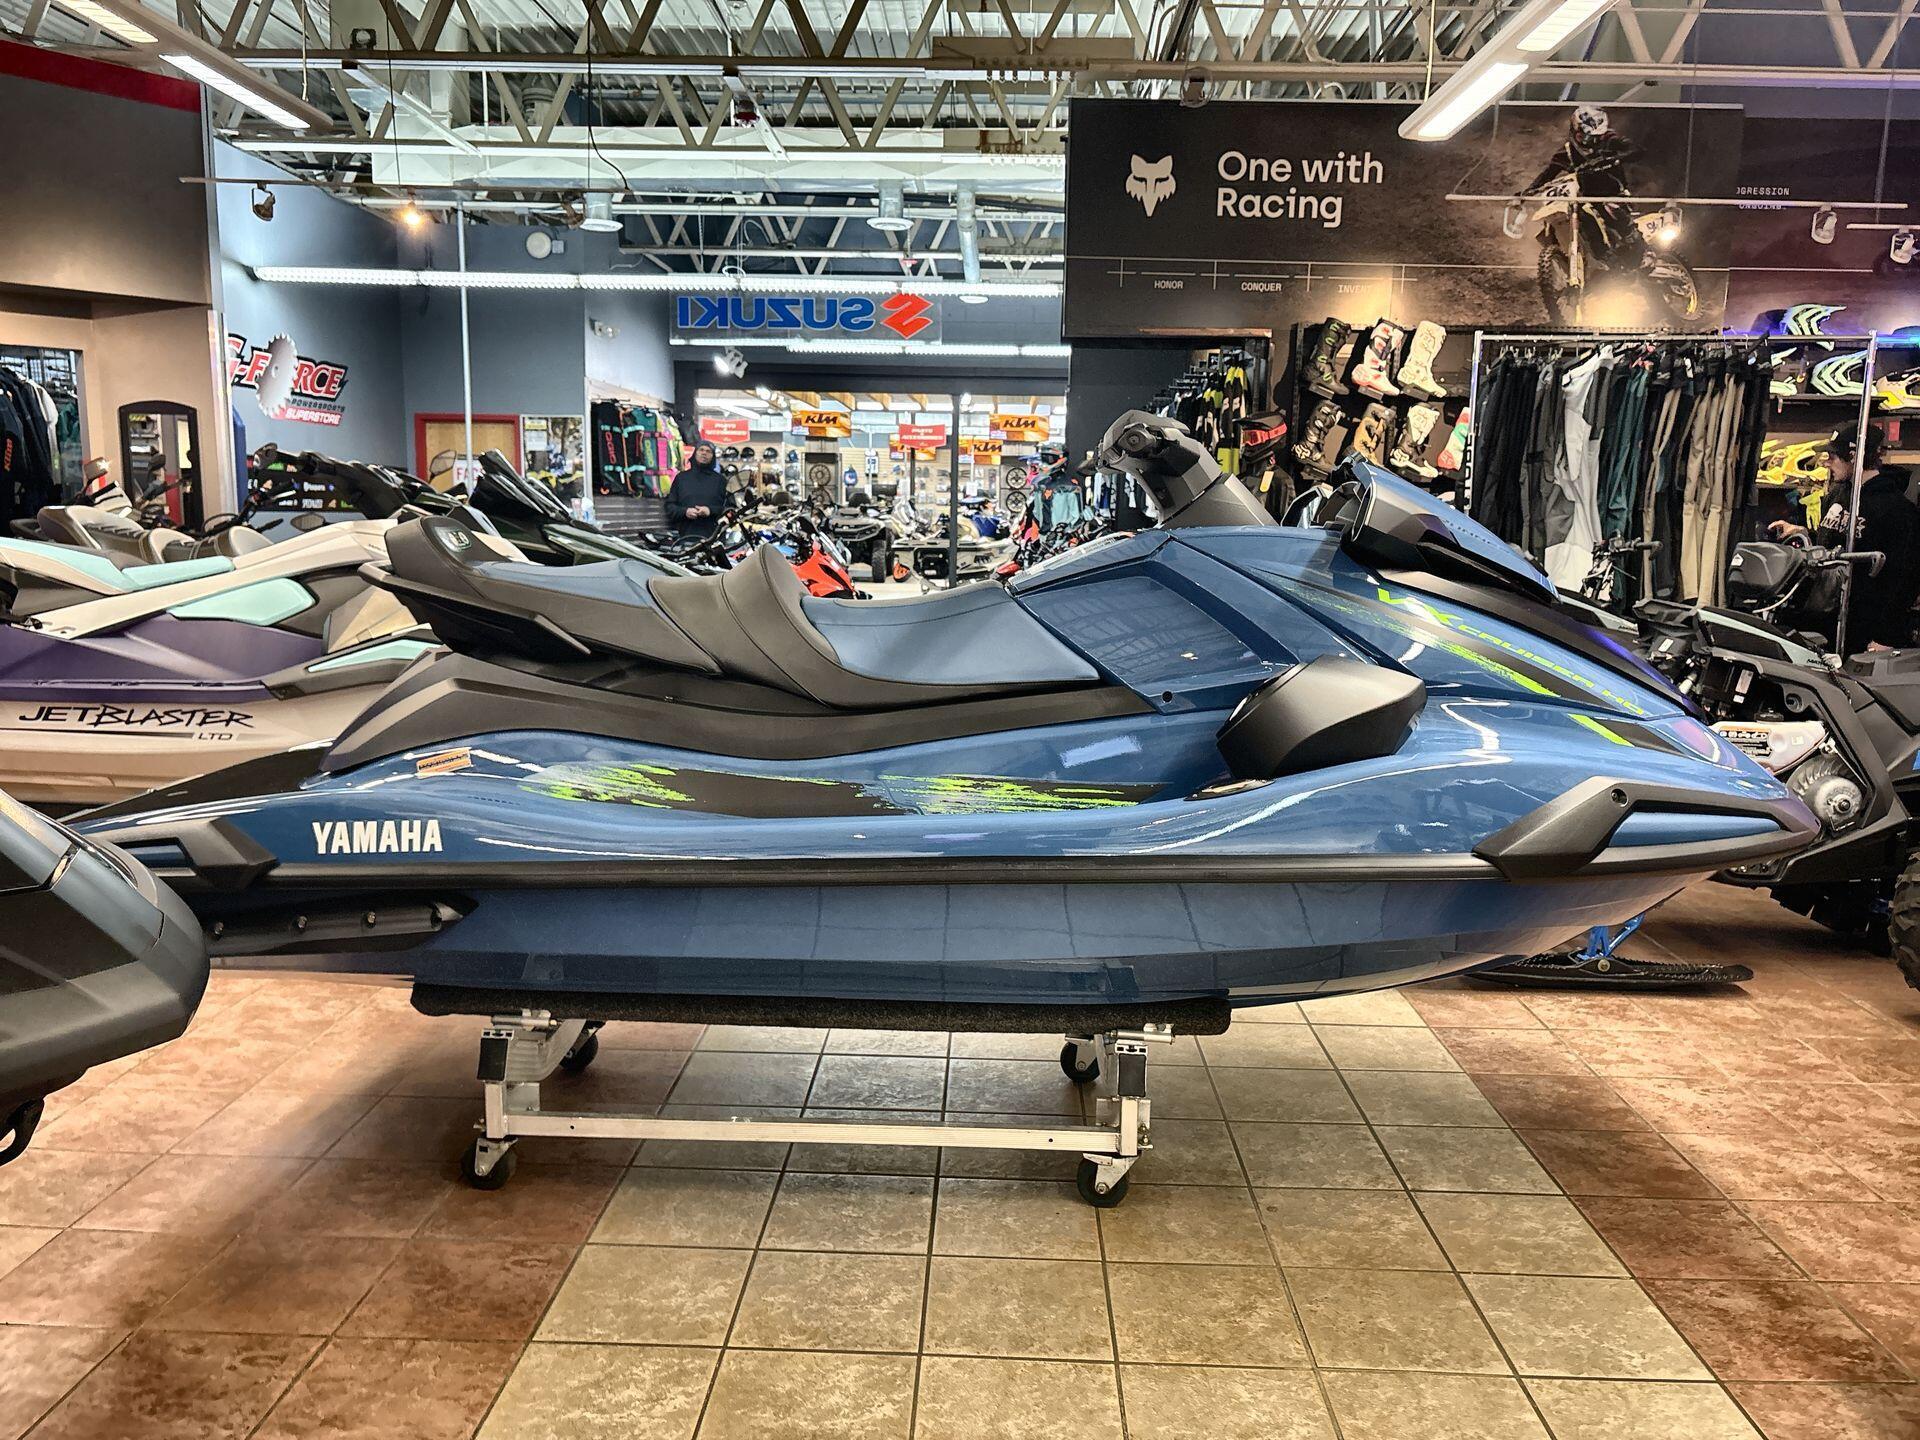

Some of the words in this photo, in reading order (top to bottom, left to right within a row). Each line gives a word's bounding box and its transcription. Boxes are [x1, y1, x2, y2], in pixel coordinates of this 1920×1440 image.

[1218, 151, 1292, 182] One
[1301, 151, 1384, 184] with
[1216, 187, 1343, 228] Racing
[1154, 280, 1184, 289] HONOR
[1241, 282, 1282, 292] CONQUER
[1338, 284, 1370, 293] INVEN
[285, 408, 341, 424] SUPERSTORE
[805, 414, 838, 424] KTM
[1003, 418, 1036, 428] KTM
[973, 442, 1002, 452] KTM
[1458, 624, 1595, 688] CRUISER
[19, 704, 254, 728] JETBLASTER
[198, 733, 233, 741] LTD
[312, 820, 443, 854] YAMAHA
